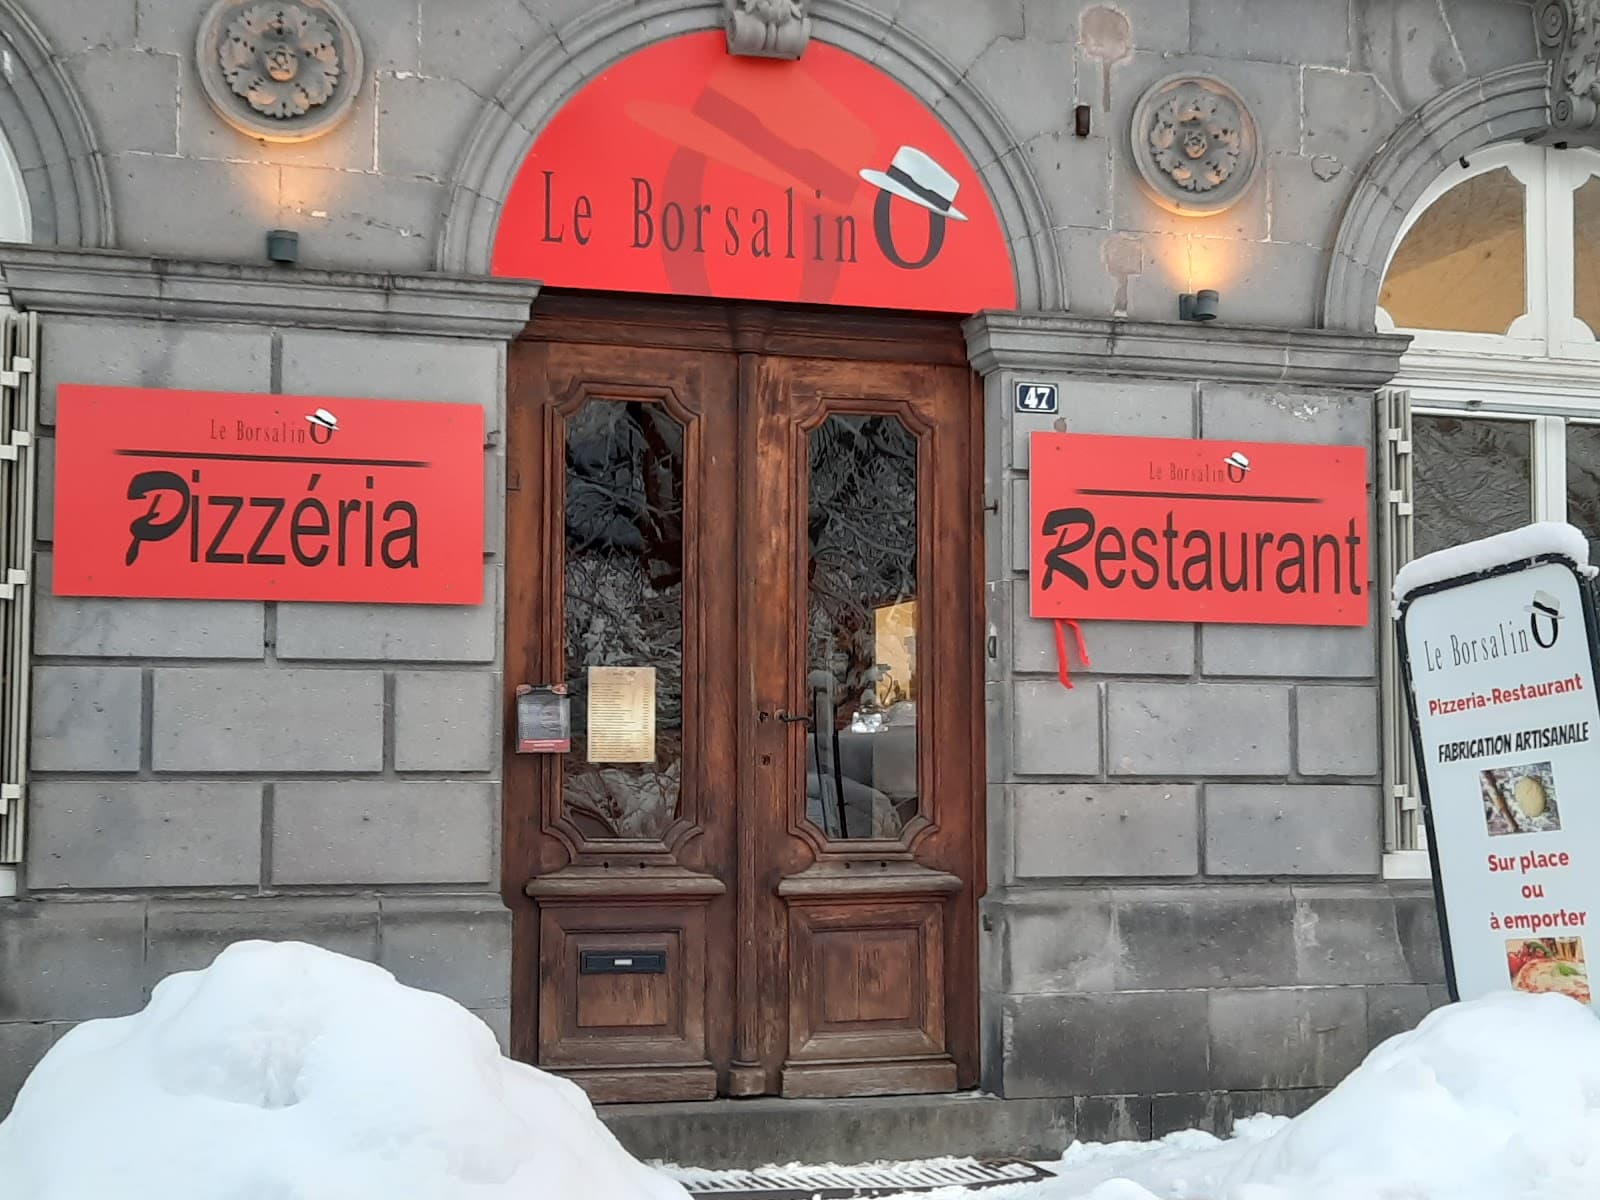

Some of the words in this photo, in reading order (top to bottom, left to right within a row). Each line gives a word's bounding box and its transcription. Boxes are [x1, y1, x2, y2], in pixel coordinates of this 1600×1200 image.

[541, 170, 592, 246] Le
[1023, 387, 1050, 409] 47
[209, 418, 227, 441] Le
[1149, 460, 1163, 481] Le
[125, 468, 420, 569] Pizzéria
[1041, 507, 1362, 595] Restaurant
[1423, 639, 1443, 672] Le
[1428, 673, 1584, 716] Pizzeria-Restaurant
[1438, 733, 1512, 763] FABRICATION
[1515, 721, 1590, 752] ARTISANALE
[1487, 854, 1516, 872] Sur
[1520, 850, 1570, 874] place
[1521, 883, 1544, 899] ou
[1490, 912, 1500, 930] à
[1504, 908, 1587, 933] emporter
